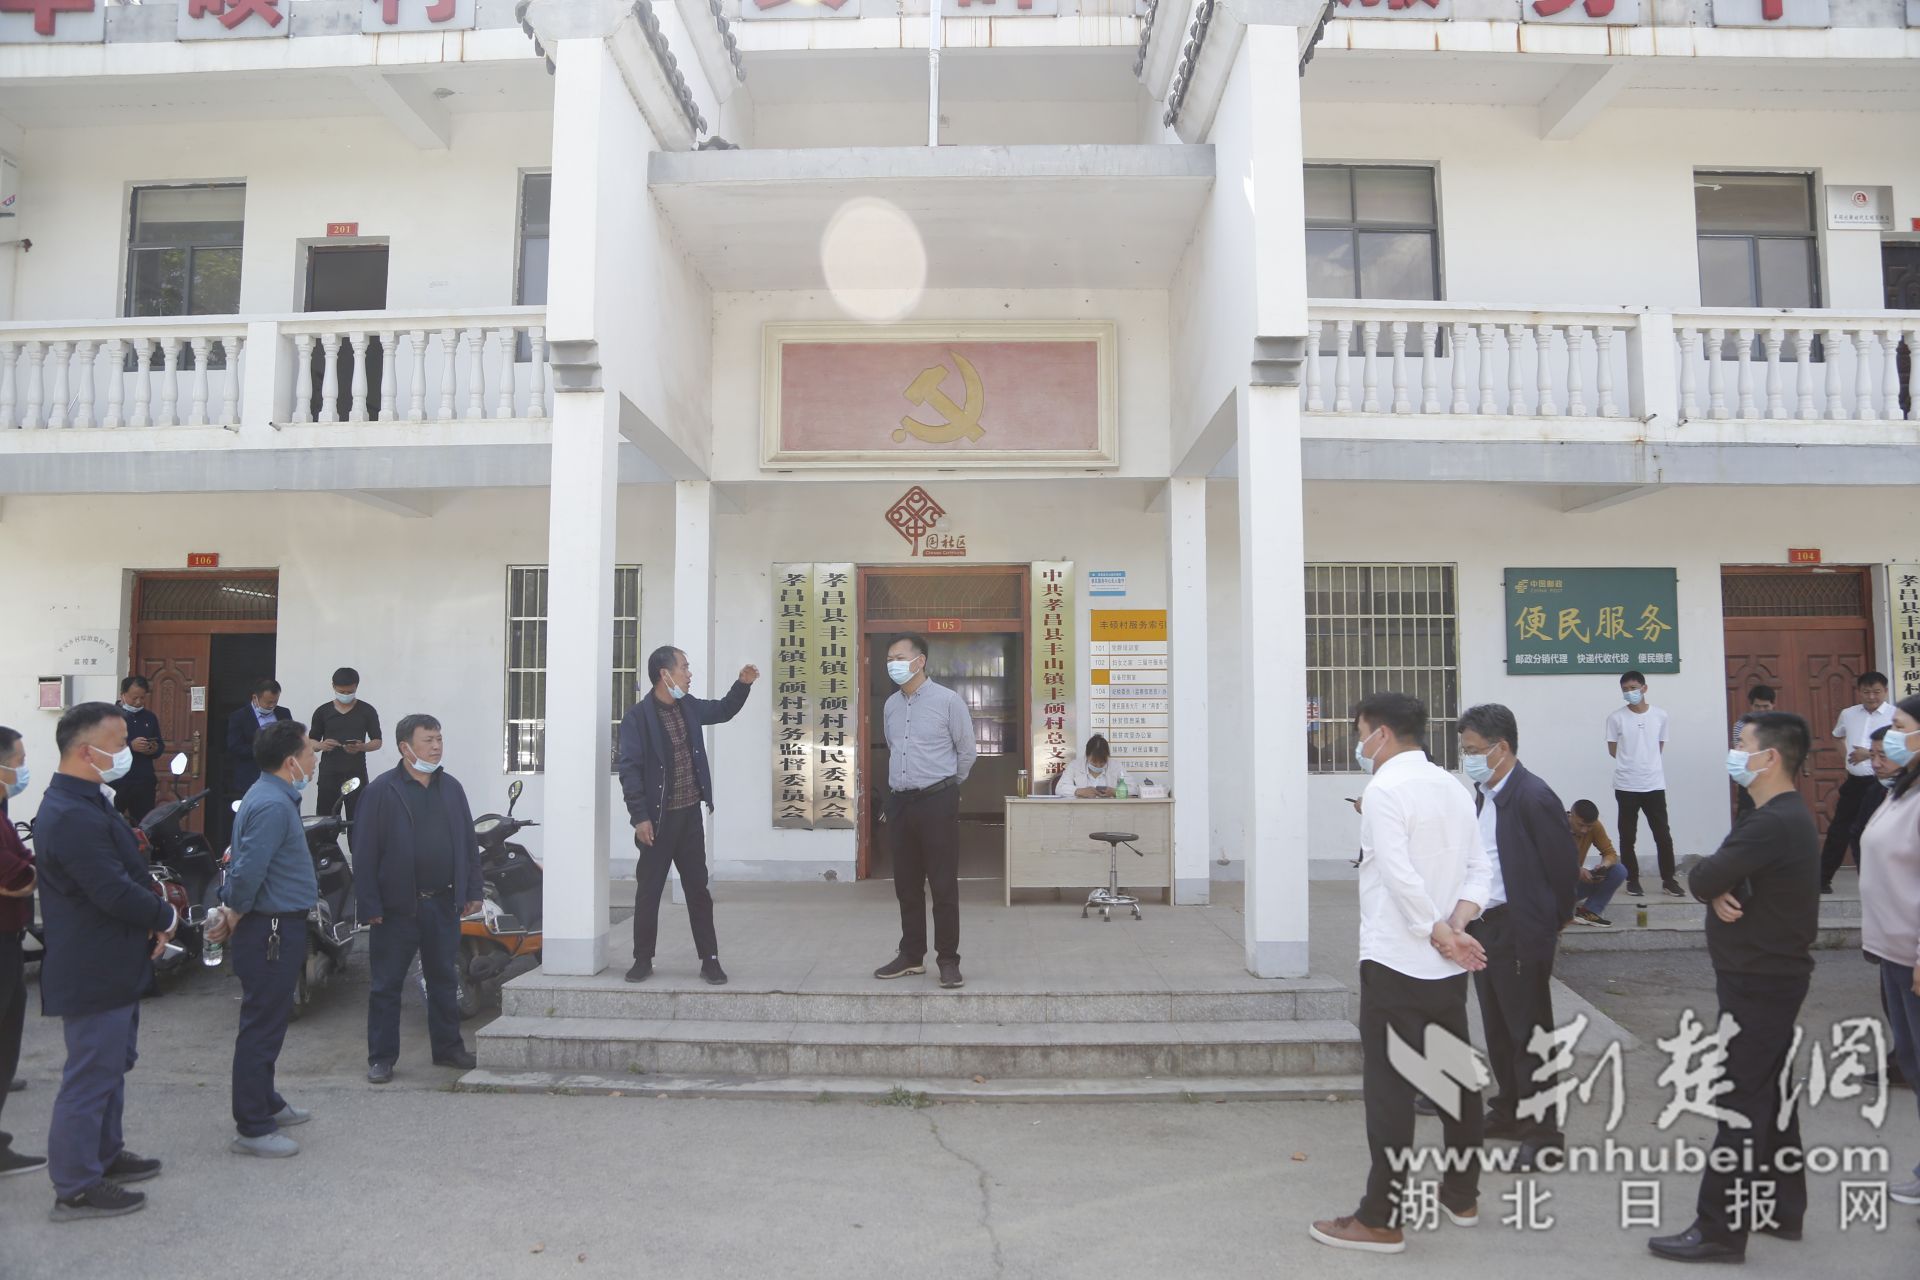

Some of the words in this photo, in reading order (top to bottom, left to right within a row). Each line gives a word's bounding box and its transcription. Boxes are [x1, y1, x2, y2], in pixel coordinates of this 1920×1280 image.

[335, 225, 350, 234] 201
[1797, 552, 1815, 560] 104
[195, 557, 212, 565] 106
[1530, 580, 1563, 588] 中国邮政
[936, 621, 955, 630] 105
[1514, 603, 1673, 643] 便民服务
[1515, 653, 1569, 664] 邮政分销代理
[1577, 653, 1630, 664] 快递代收代投
[1638, 653, 1674, 664] 便民缴费
[778, 573, 807, 819] 孝昌县丰山镇丰硕村村务监督委员会
[819, 572, 848, 818] 孝昌县丰山镇丰硕村村民委员会
